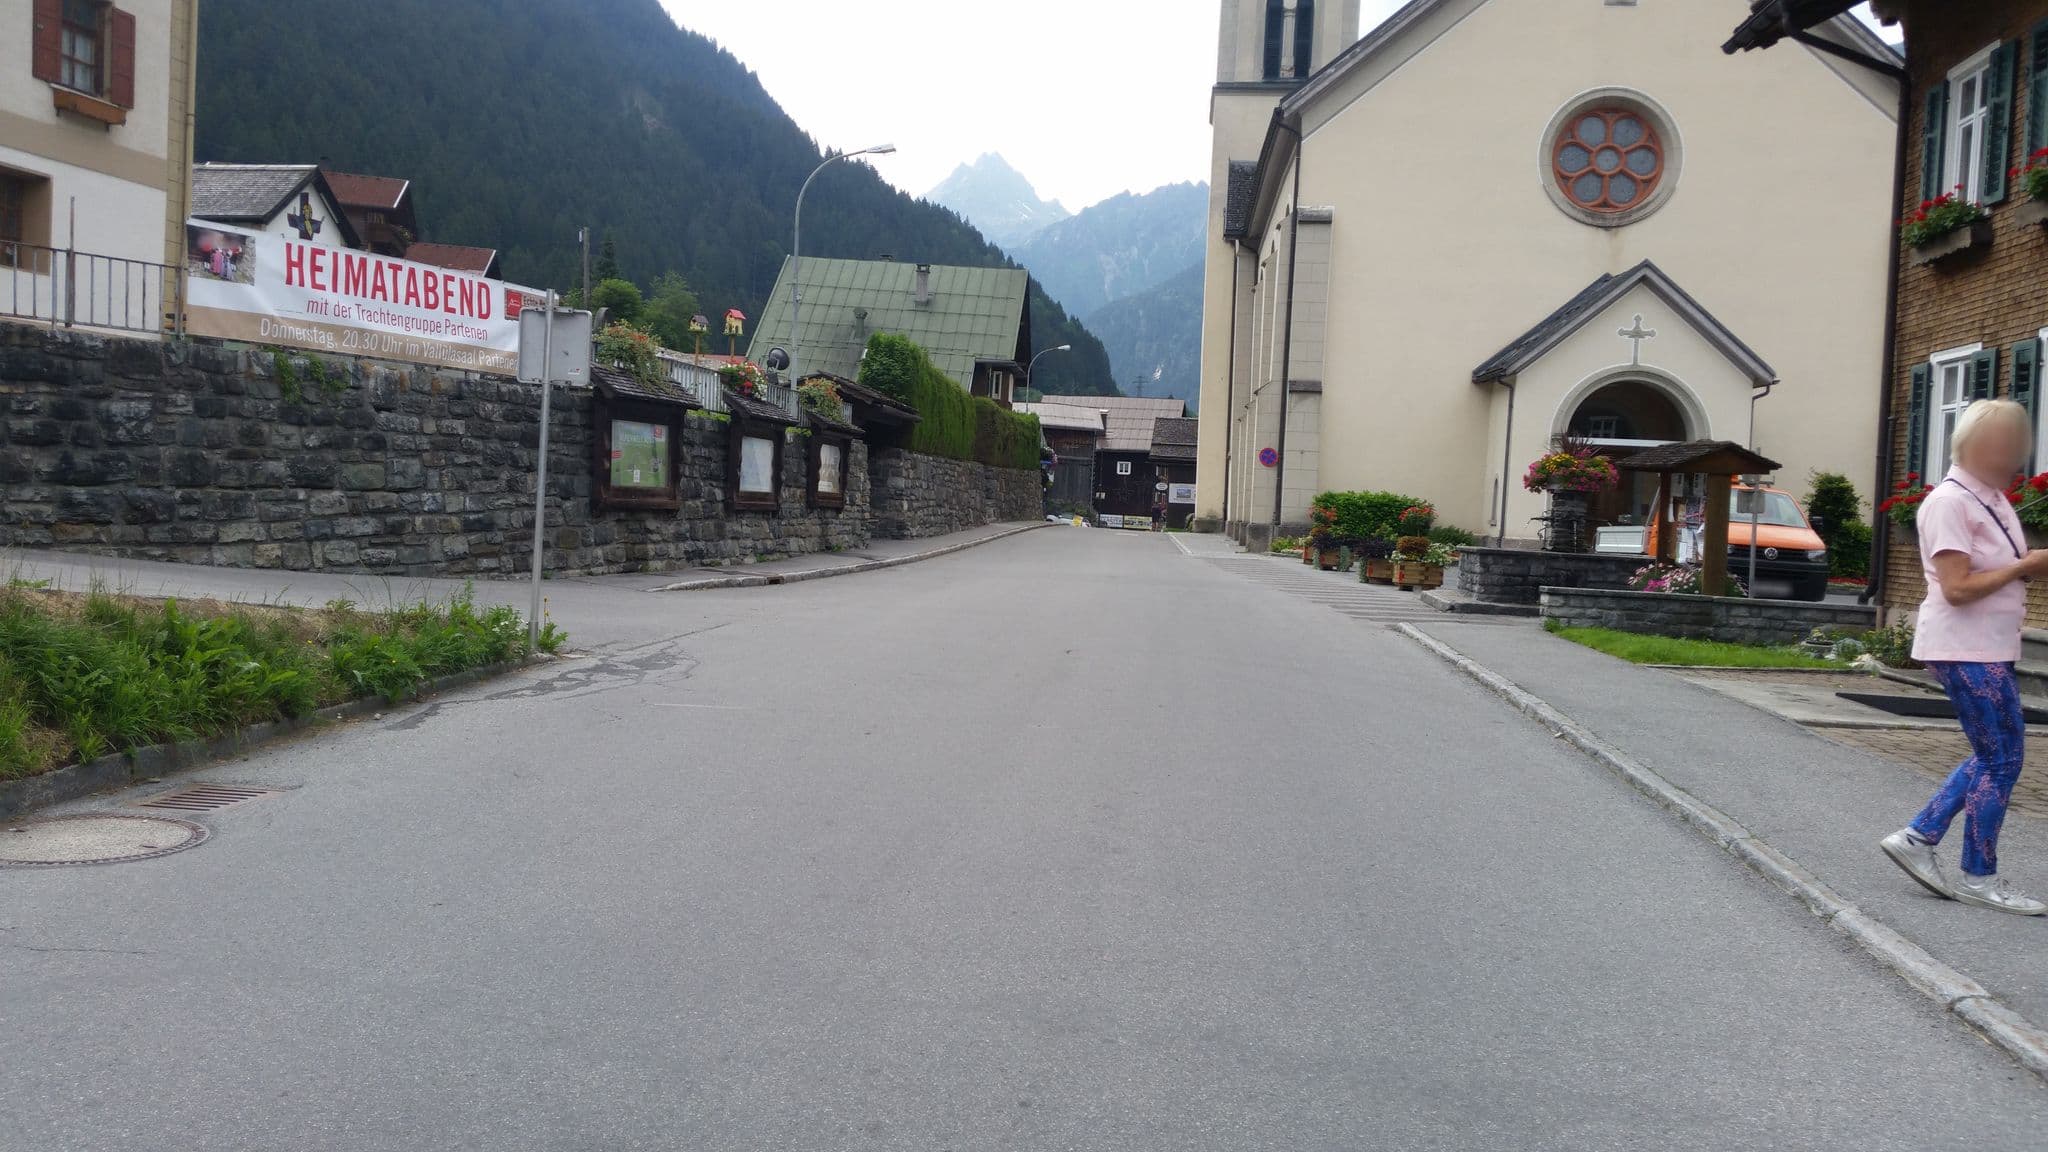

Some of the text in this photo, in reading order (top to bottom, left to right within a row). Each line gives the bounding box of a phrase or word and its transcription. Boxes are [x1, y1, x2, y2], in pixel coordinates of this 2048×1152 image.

[285, 242, 491, 320] HEIMATABEND
[260, 317, 338, 349] Donnerstag,
[342, 329, 378, 351] 20.30
[381, 335, 403, 354] Uhr
[405, 338, 419, 358] im
[306, 298, 488, 341] mit der Trachtengruppe Partenen
